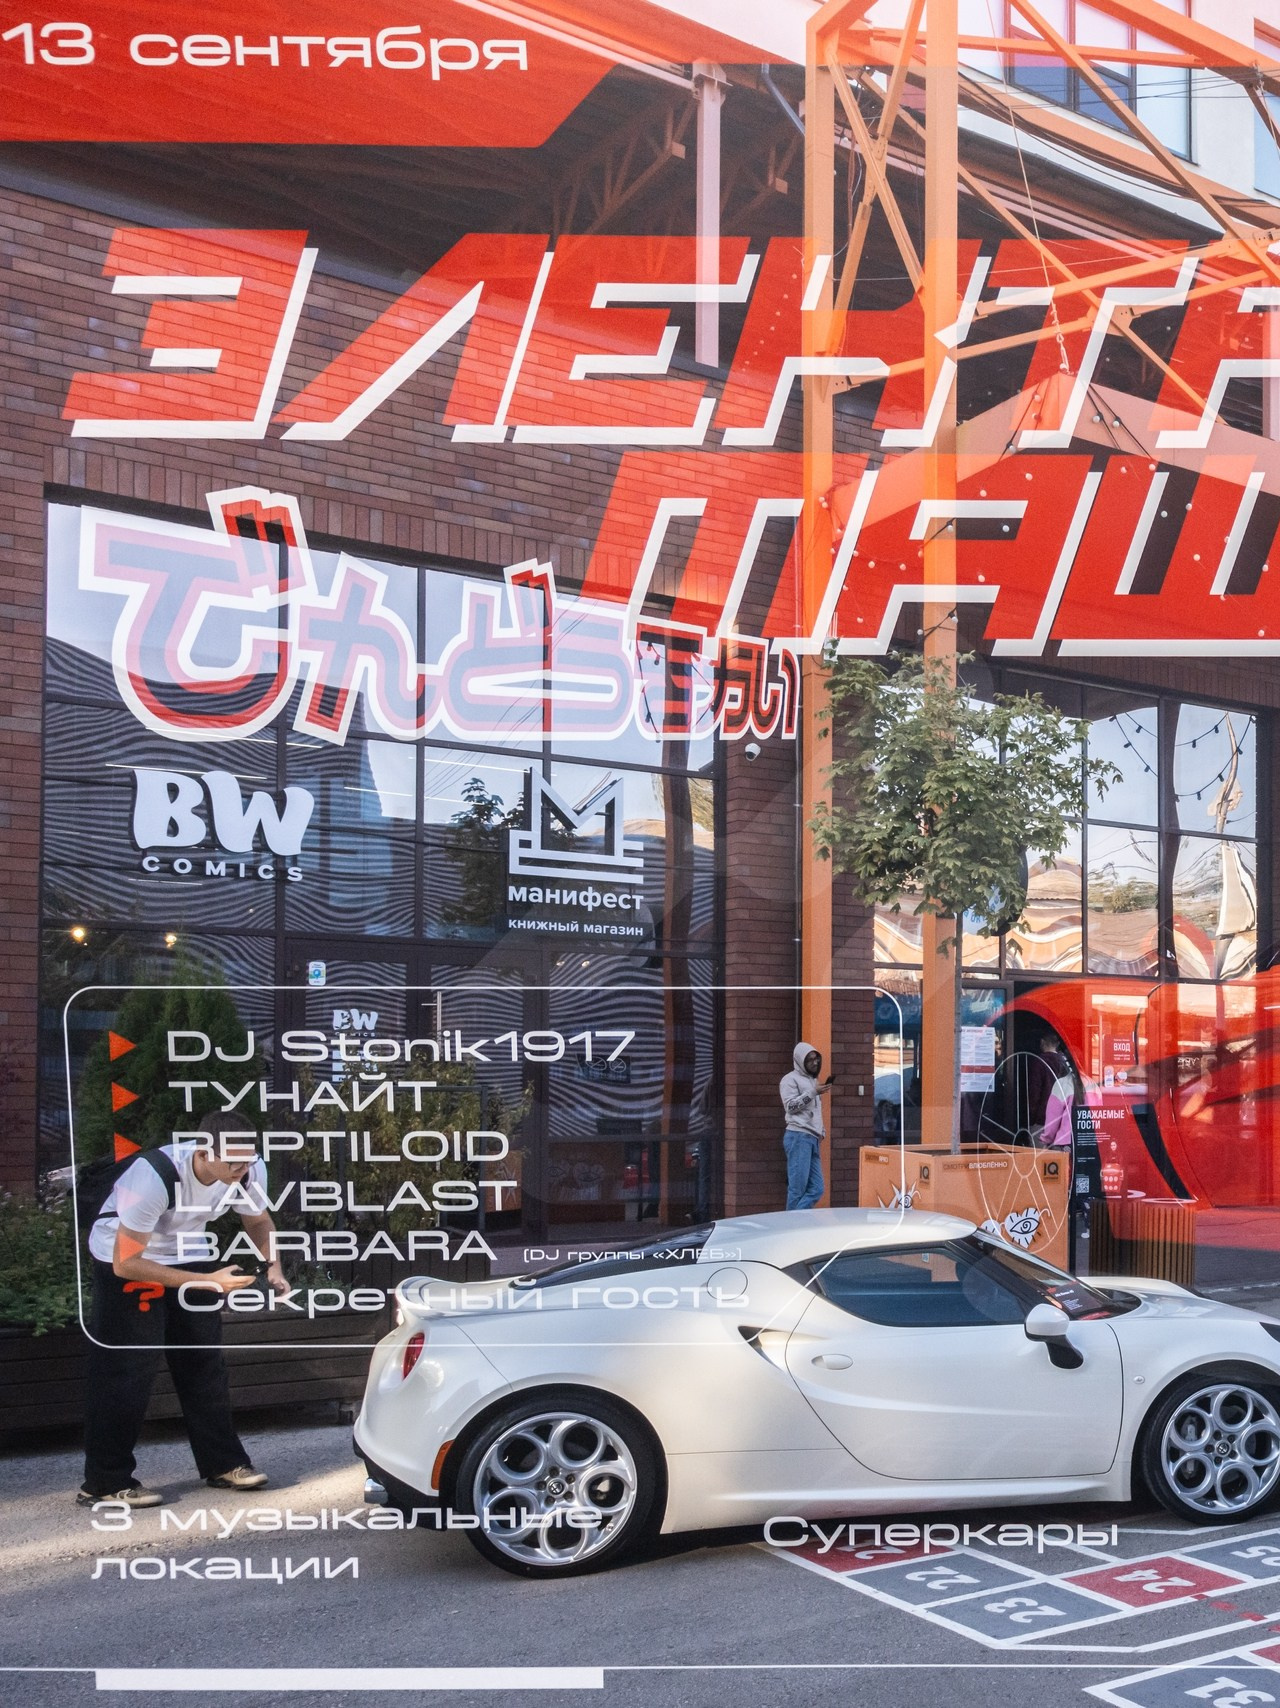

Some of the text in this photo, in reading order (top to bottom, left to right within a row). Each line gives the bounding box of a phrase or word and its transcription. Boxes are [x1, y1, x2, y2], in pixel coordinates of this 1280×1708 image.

[131, 769, 316, 857] BW
[141, 854, 304, 883] COMICS
[508, 885, 645, 912] манифест
[508, 918, 644, 938] книжный магазин
[333, 1008, 379, 1031] BW
[1113, 1042, 1131, 1052] ВХОД
[1077, 1109, 1125, 1119] УВАЖАЕМЫЕ
[1077, 1120, 1101, 1129] ГОСТИ
[919, 1165, 930, 1180] IQ
[1043, 1161, 1059, 1176] IQ
[905, 1566, 981, 1591] 22
[1113, 1568, 1196, 1594] 24
[983, 1596, 1067, 1624] 23
[1184, 1676, 1276, 1708] 31
